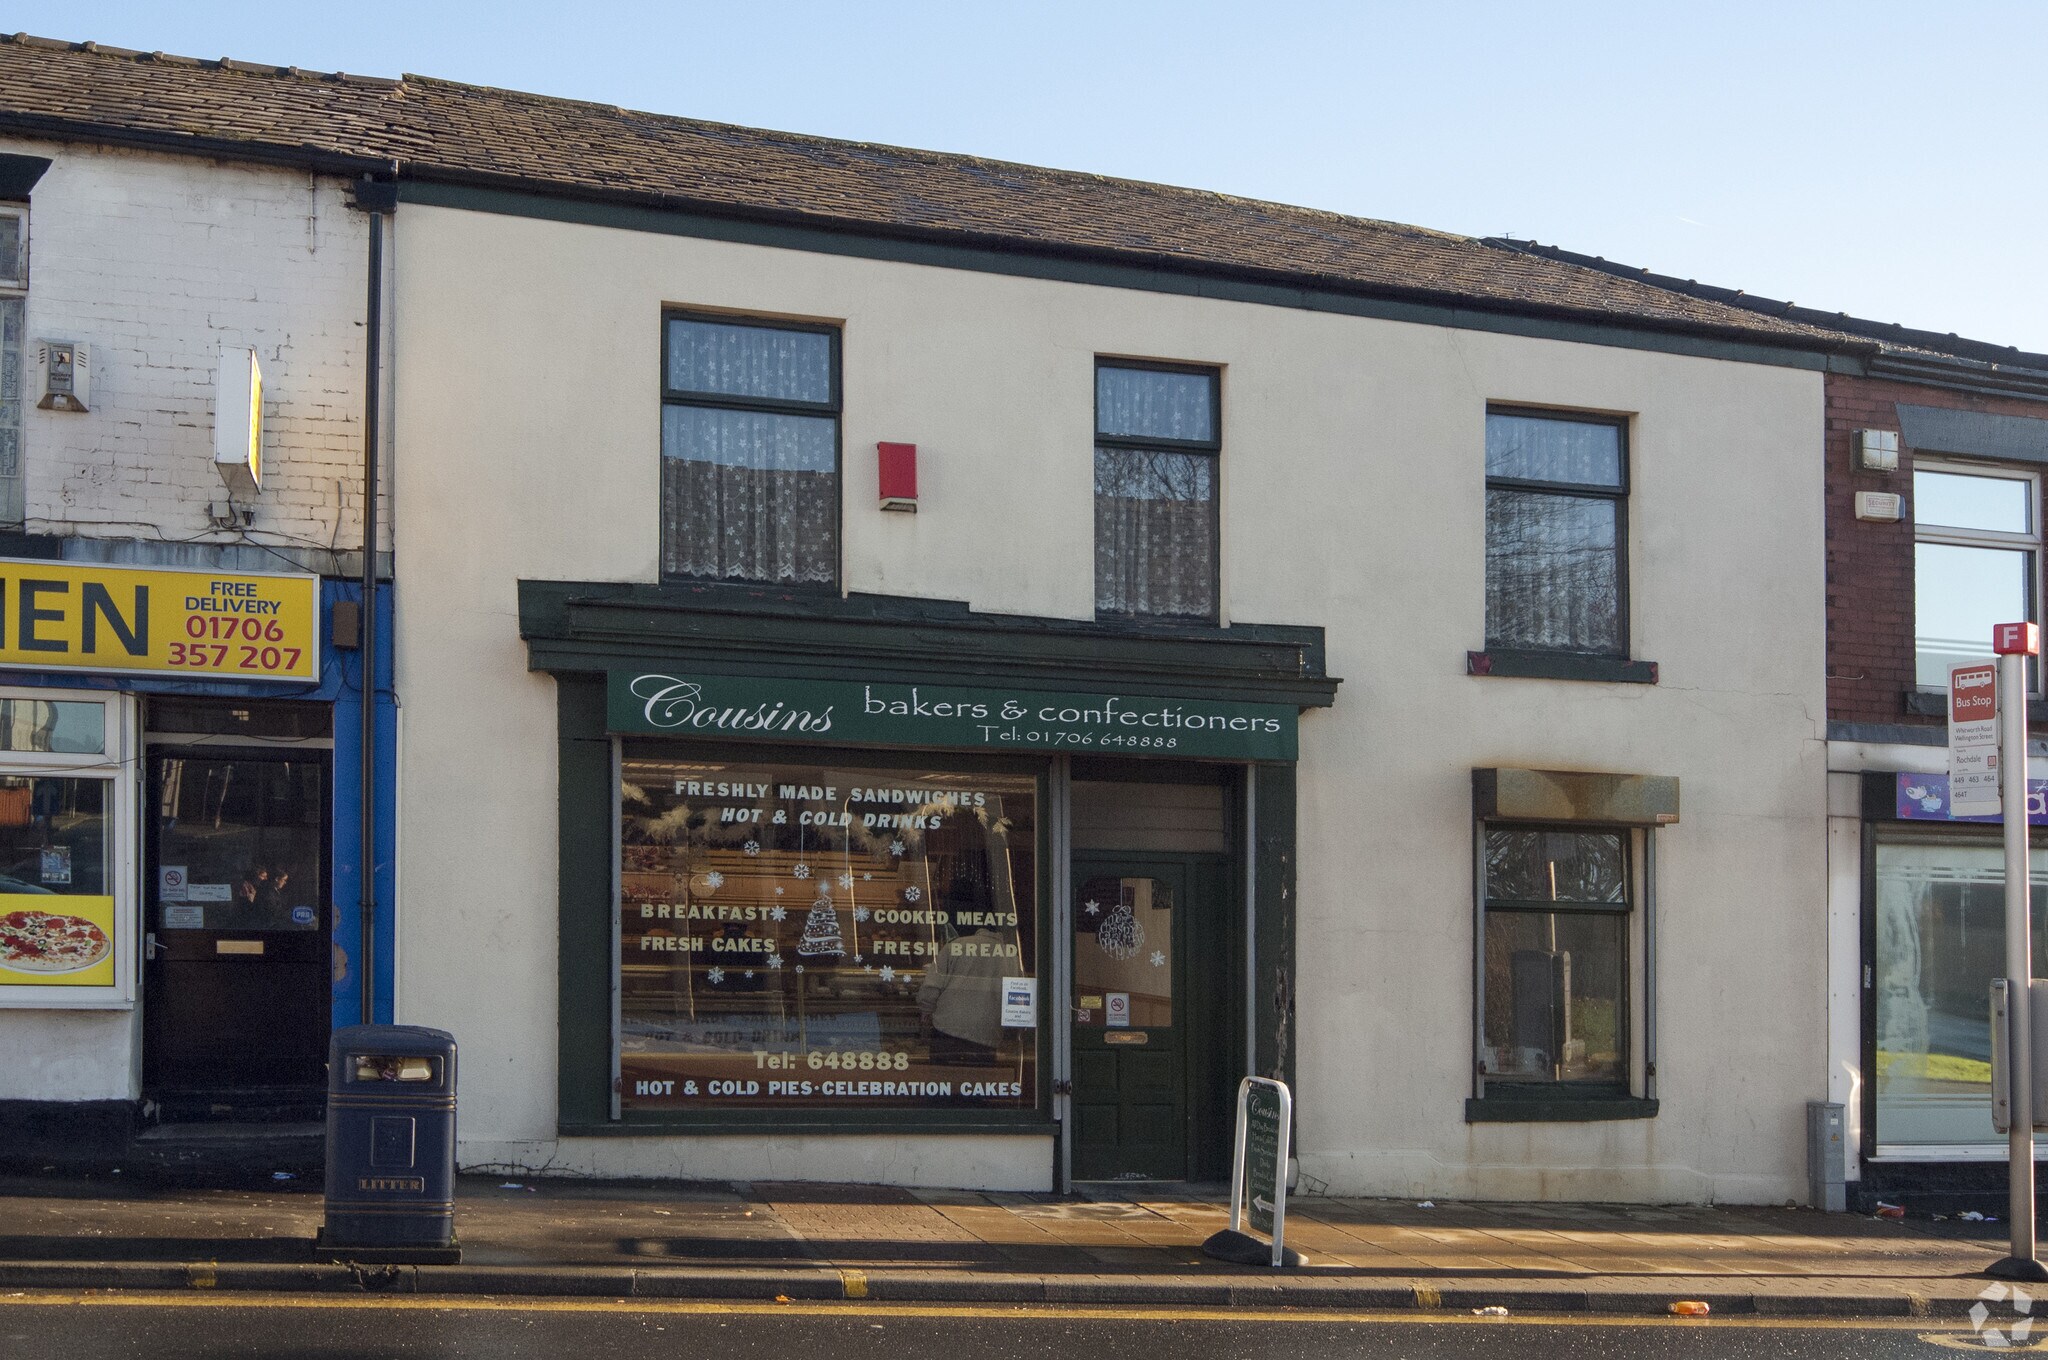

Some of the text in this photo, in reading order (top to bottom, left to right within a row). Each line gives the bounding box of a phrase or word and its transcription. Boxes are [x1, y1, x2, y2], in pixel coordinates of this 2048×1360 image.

[210, 581, 257, 598] FREE
[185, 596, 282, 615] DELIVERY
[0, 576, 149, 657] EN
[186, 615, 284, 642] 01706
[2003, 626, 2018, 649] F
[167, 642, 302, 670] 357 207
[630, 674, 833, 732] Cousins
[863, 685, 1281, 733] bakers & confectioners
[1956, 695, 1992, 708] Bus Stop
[976, 725, 1178, 749] Tel: 01706 648888
[1956, 755, 1982, 764] Rochdale
[1954, 776, 1965, 784] 449
[674, 780, 986, 807] FRESHLY MADE SANDWICHES
[720, 807, 942, 830] HOT & COLD DRINKS
[641, 903, 769, 921] BREAKFAST
[873, 909, 1017, 927] COOKED MEATS
[641, 937, 776, 953] FRESH CAKES
[872, 940, 1018, 958] FRESH BREAD
[753, 1051, 909, 1071] Tel: 648888
[636, 1080, 675, 1095] HOT
[684, 1081, 698, 1095] &
[708, 1081, 760, 1095] COLD
[960, 1081, 1022, 1096] CAKES
[361, 1178, 420, 1190] LITTER
